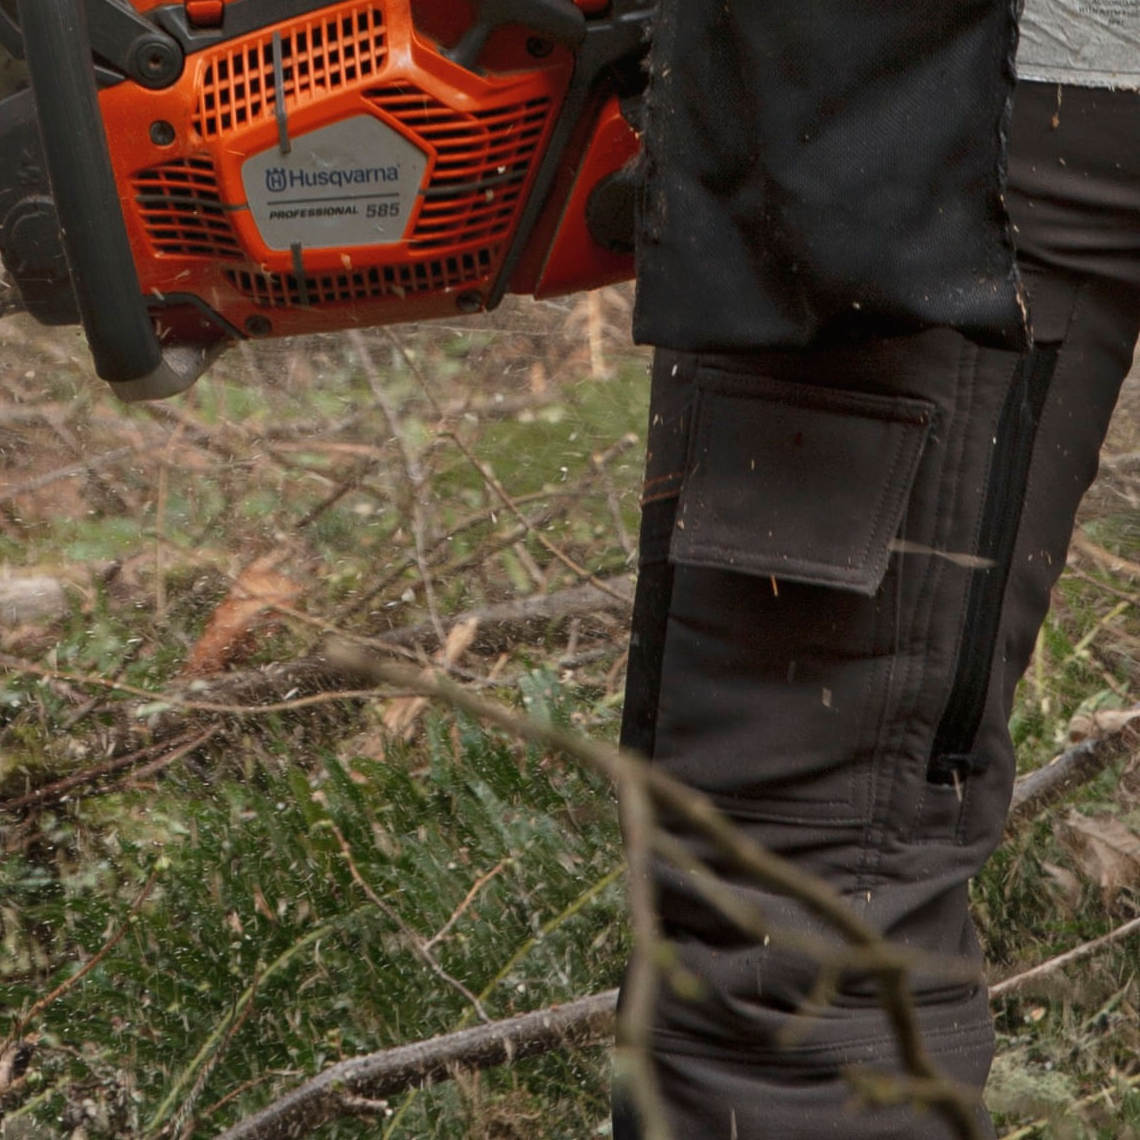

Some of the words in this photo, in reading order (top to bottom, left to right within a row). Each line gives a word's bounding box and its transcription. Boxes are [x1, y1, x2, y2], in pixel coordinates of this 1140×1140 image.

[289, 166, 399, 188] Husqvarna
[269, 205, 359, 220] PROFESSIONAL
[366, 202, 400, 218] 585
